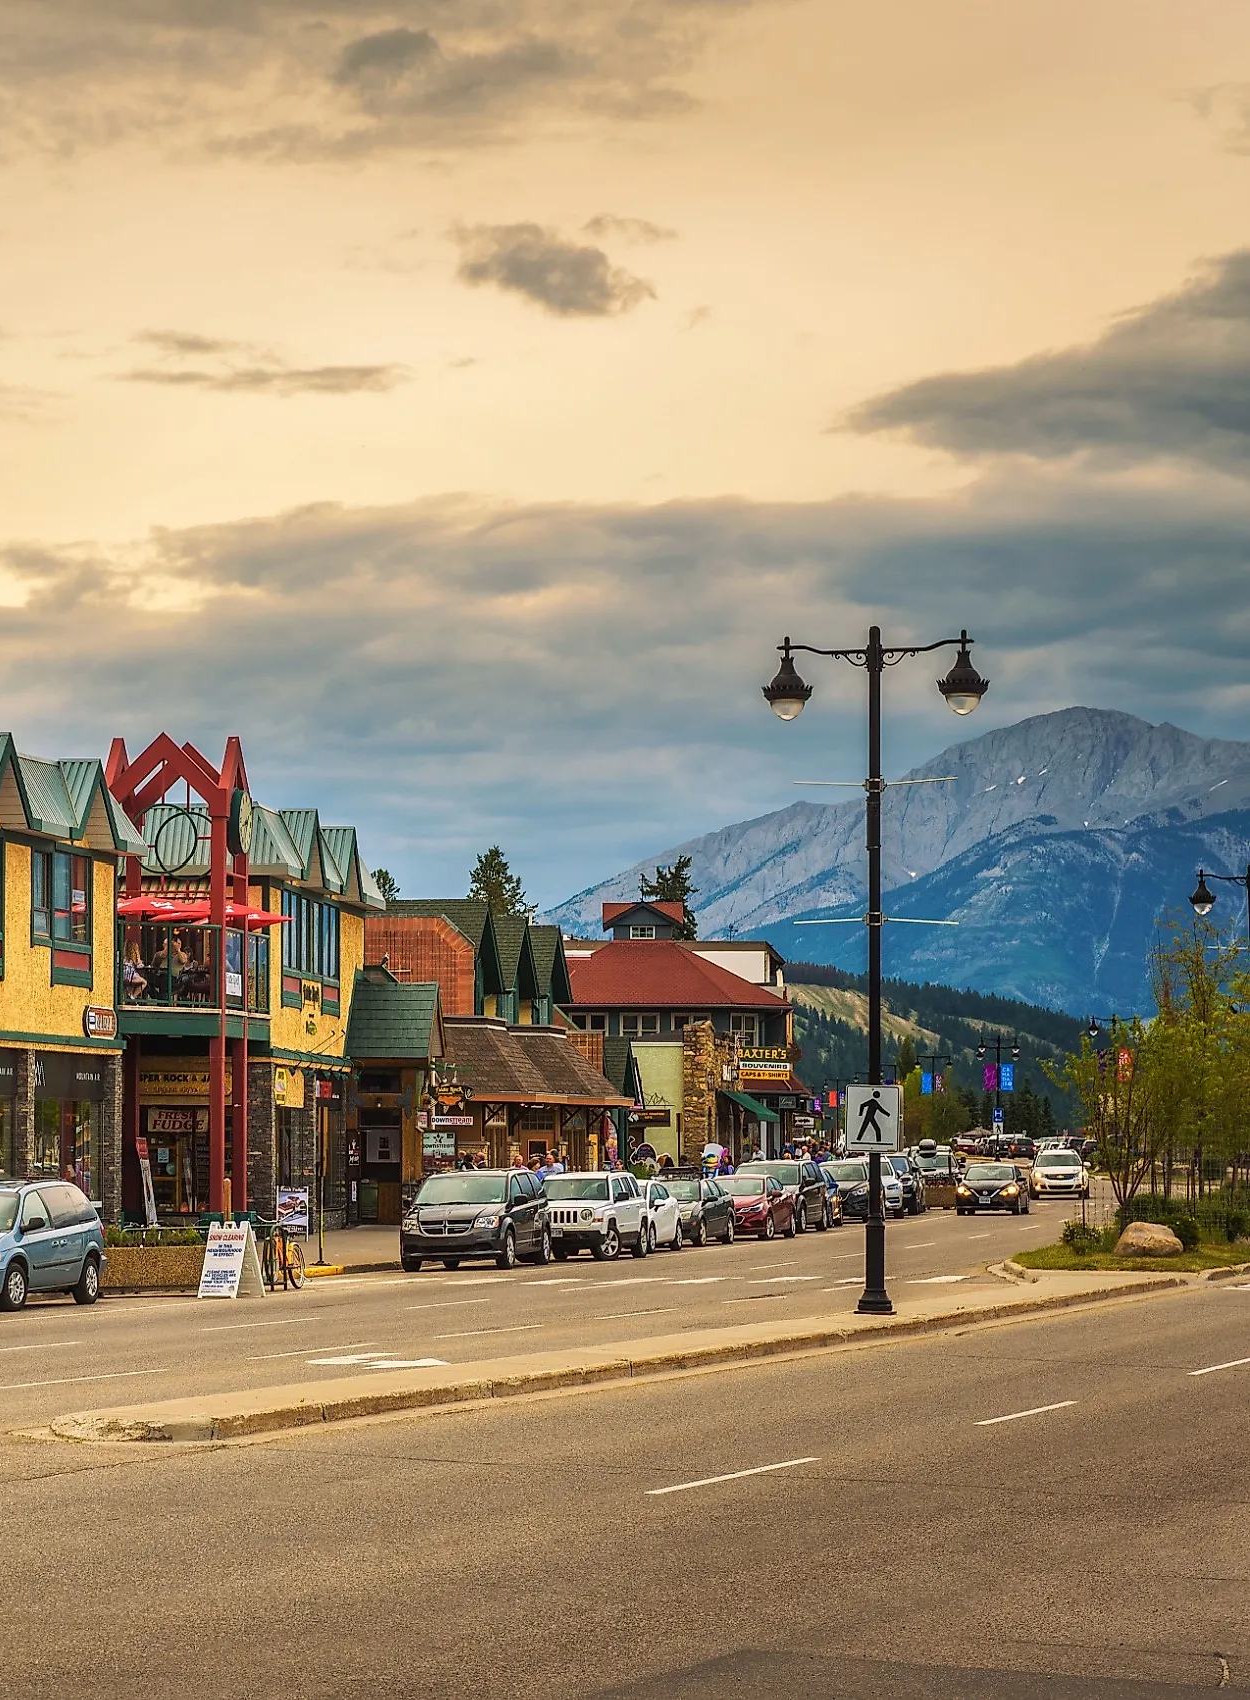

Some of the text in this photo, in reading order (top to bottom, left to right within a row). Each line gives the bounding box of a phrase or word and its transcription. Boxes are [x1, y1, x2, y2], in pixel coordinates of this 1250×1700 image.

[737, 1047, 787, 1059] BAXTER'S
[741, 1062, 788, 1070] SOUVENIRS
[164, 1074, 189, 1082] ROCK
[740, 1071, 757, 1079] CAPS
[157, 1110, 199, 1120] FRESH
[994, 1110, 1003, 1118] H
[152, 1119, 205, 1130] FUDGE
